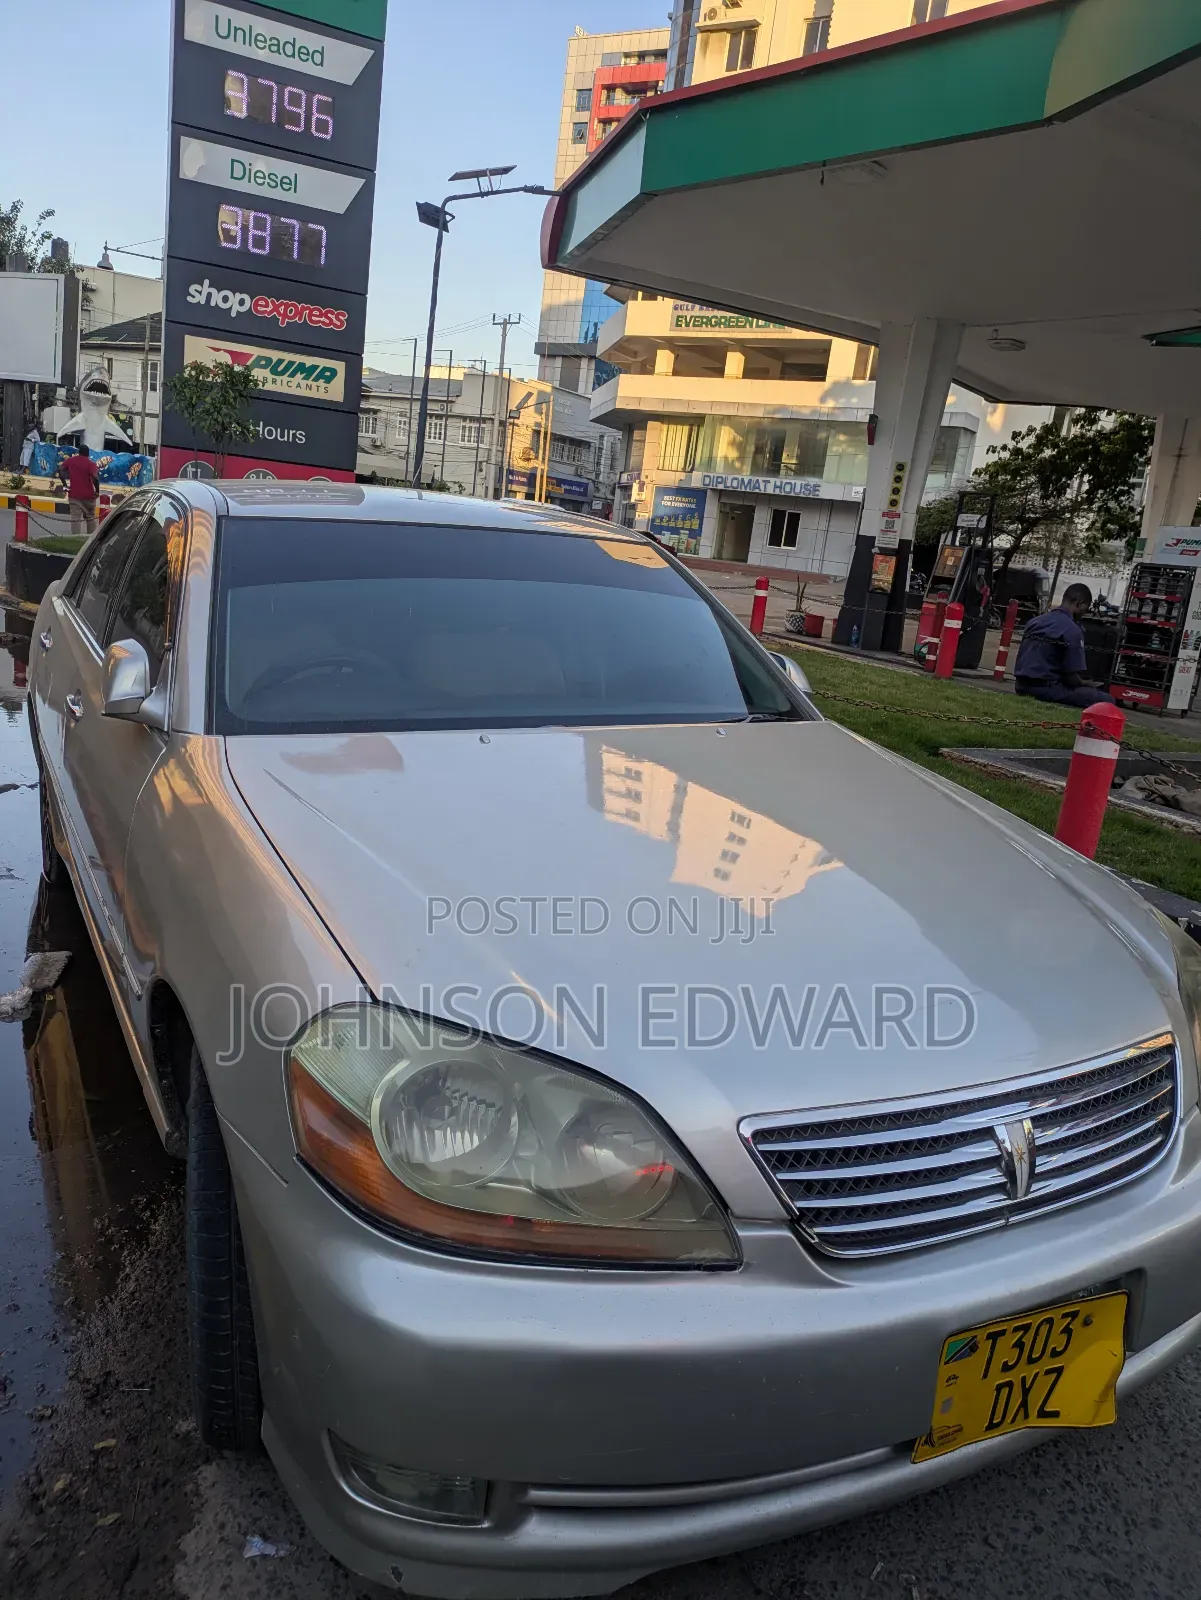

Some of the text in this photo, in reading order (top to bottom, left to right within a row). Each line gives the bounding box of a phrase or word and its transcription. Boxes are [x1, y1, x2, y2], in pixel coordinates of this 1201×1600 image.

[214, 14, 325, 68] Unleaded
[226, 70, 334, 140] 3796
[229, 158, 298, 194] Diesel
[222, 204, 327, 265] 3877
[186, 278, 348, 330] shop express
[675, 315, 754, 329] EVERGREEN
[250, 355, 338, 385] PUMA
[252, 374, 330, 394] BRICANTS
[250, 420, 306, 444] Hours
[702, 474, 821, 497] DIPLOMAT HOUSE
[981, 1309, 1080, 1380] T303
[984, 1364, 1065, 1432] DXZ
